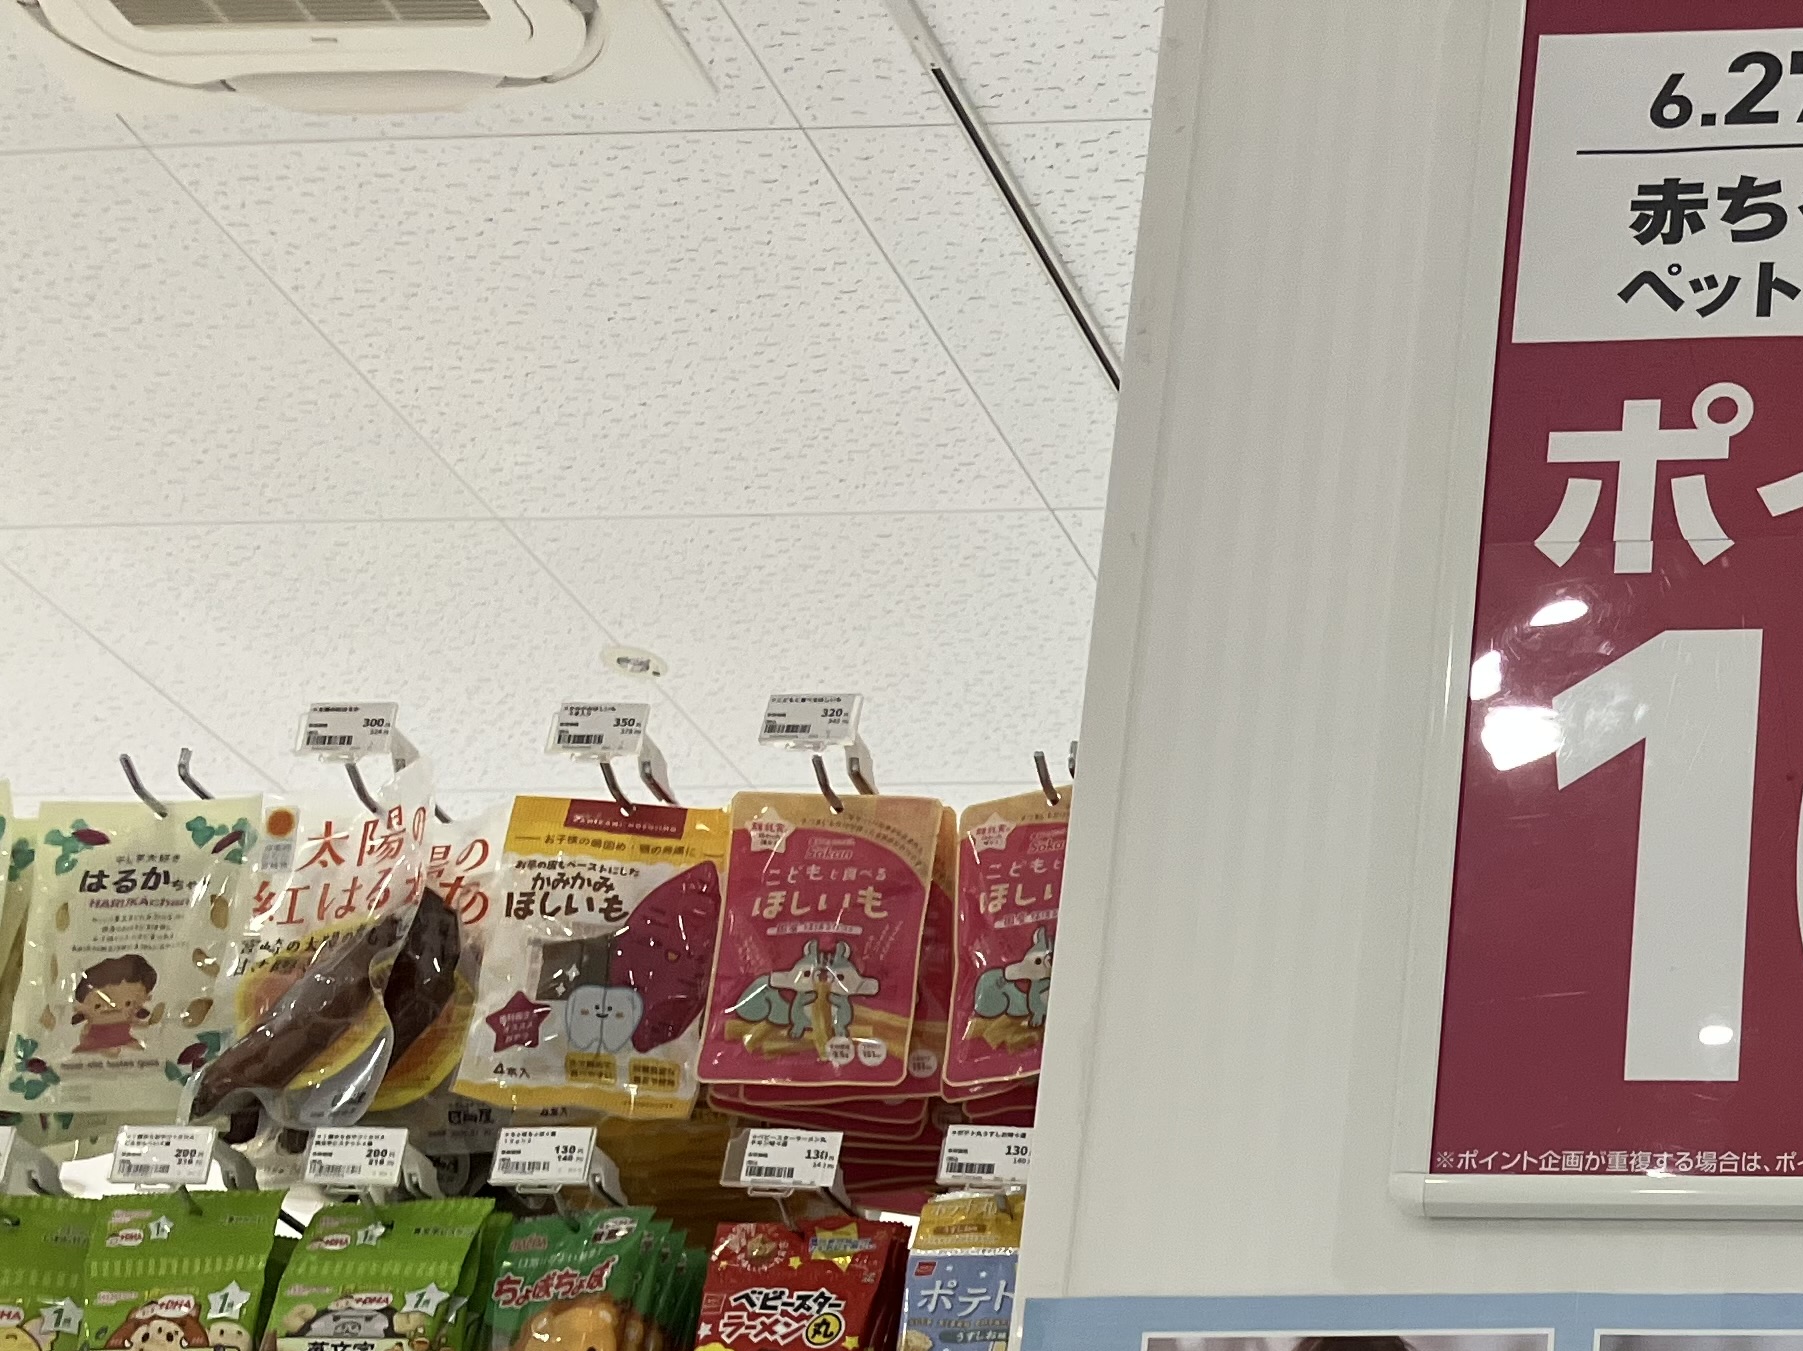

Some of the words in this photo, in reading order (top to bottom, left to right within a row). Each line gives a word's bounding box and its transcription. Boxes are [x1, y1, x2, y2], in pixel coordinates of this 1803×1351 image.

[531, 872, 615, 893] かみかみ
[505, 891, 629, 922] ほしいも
[751, 886, 888, 920] ほしいも
[730, 1287, 845, 1316] ベビースター
